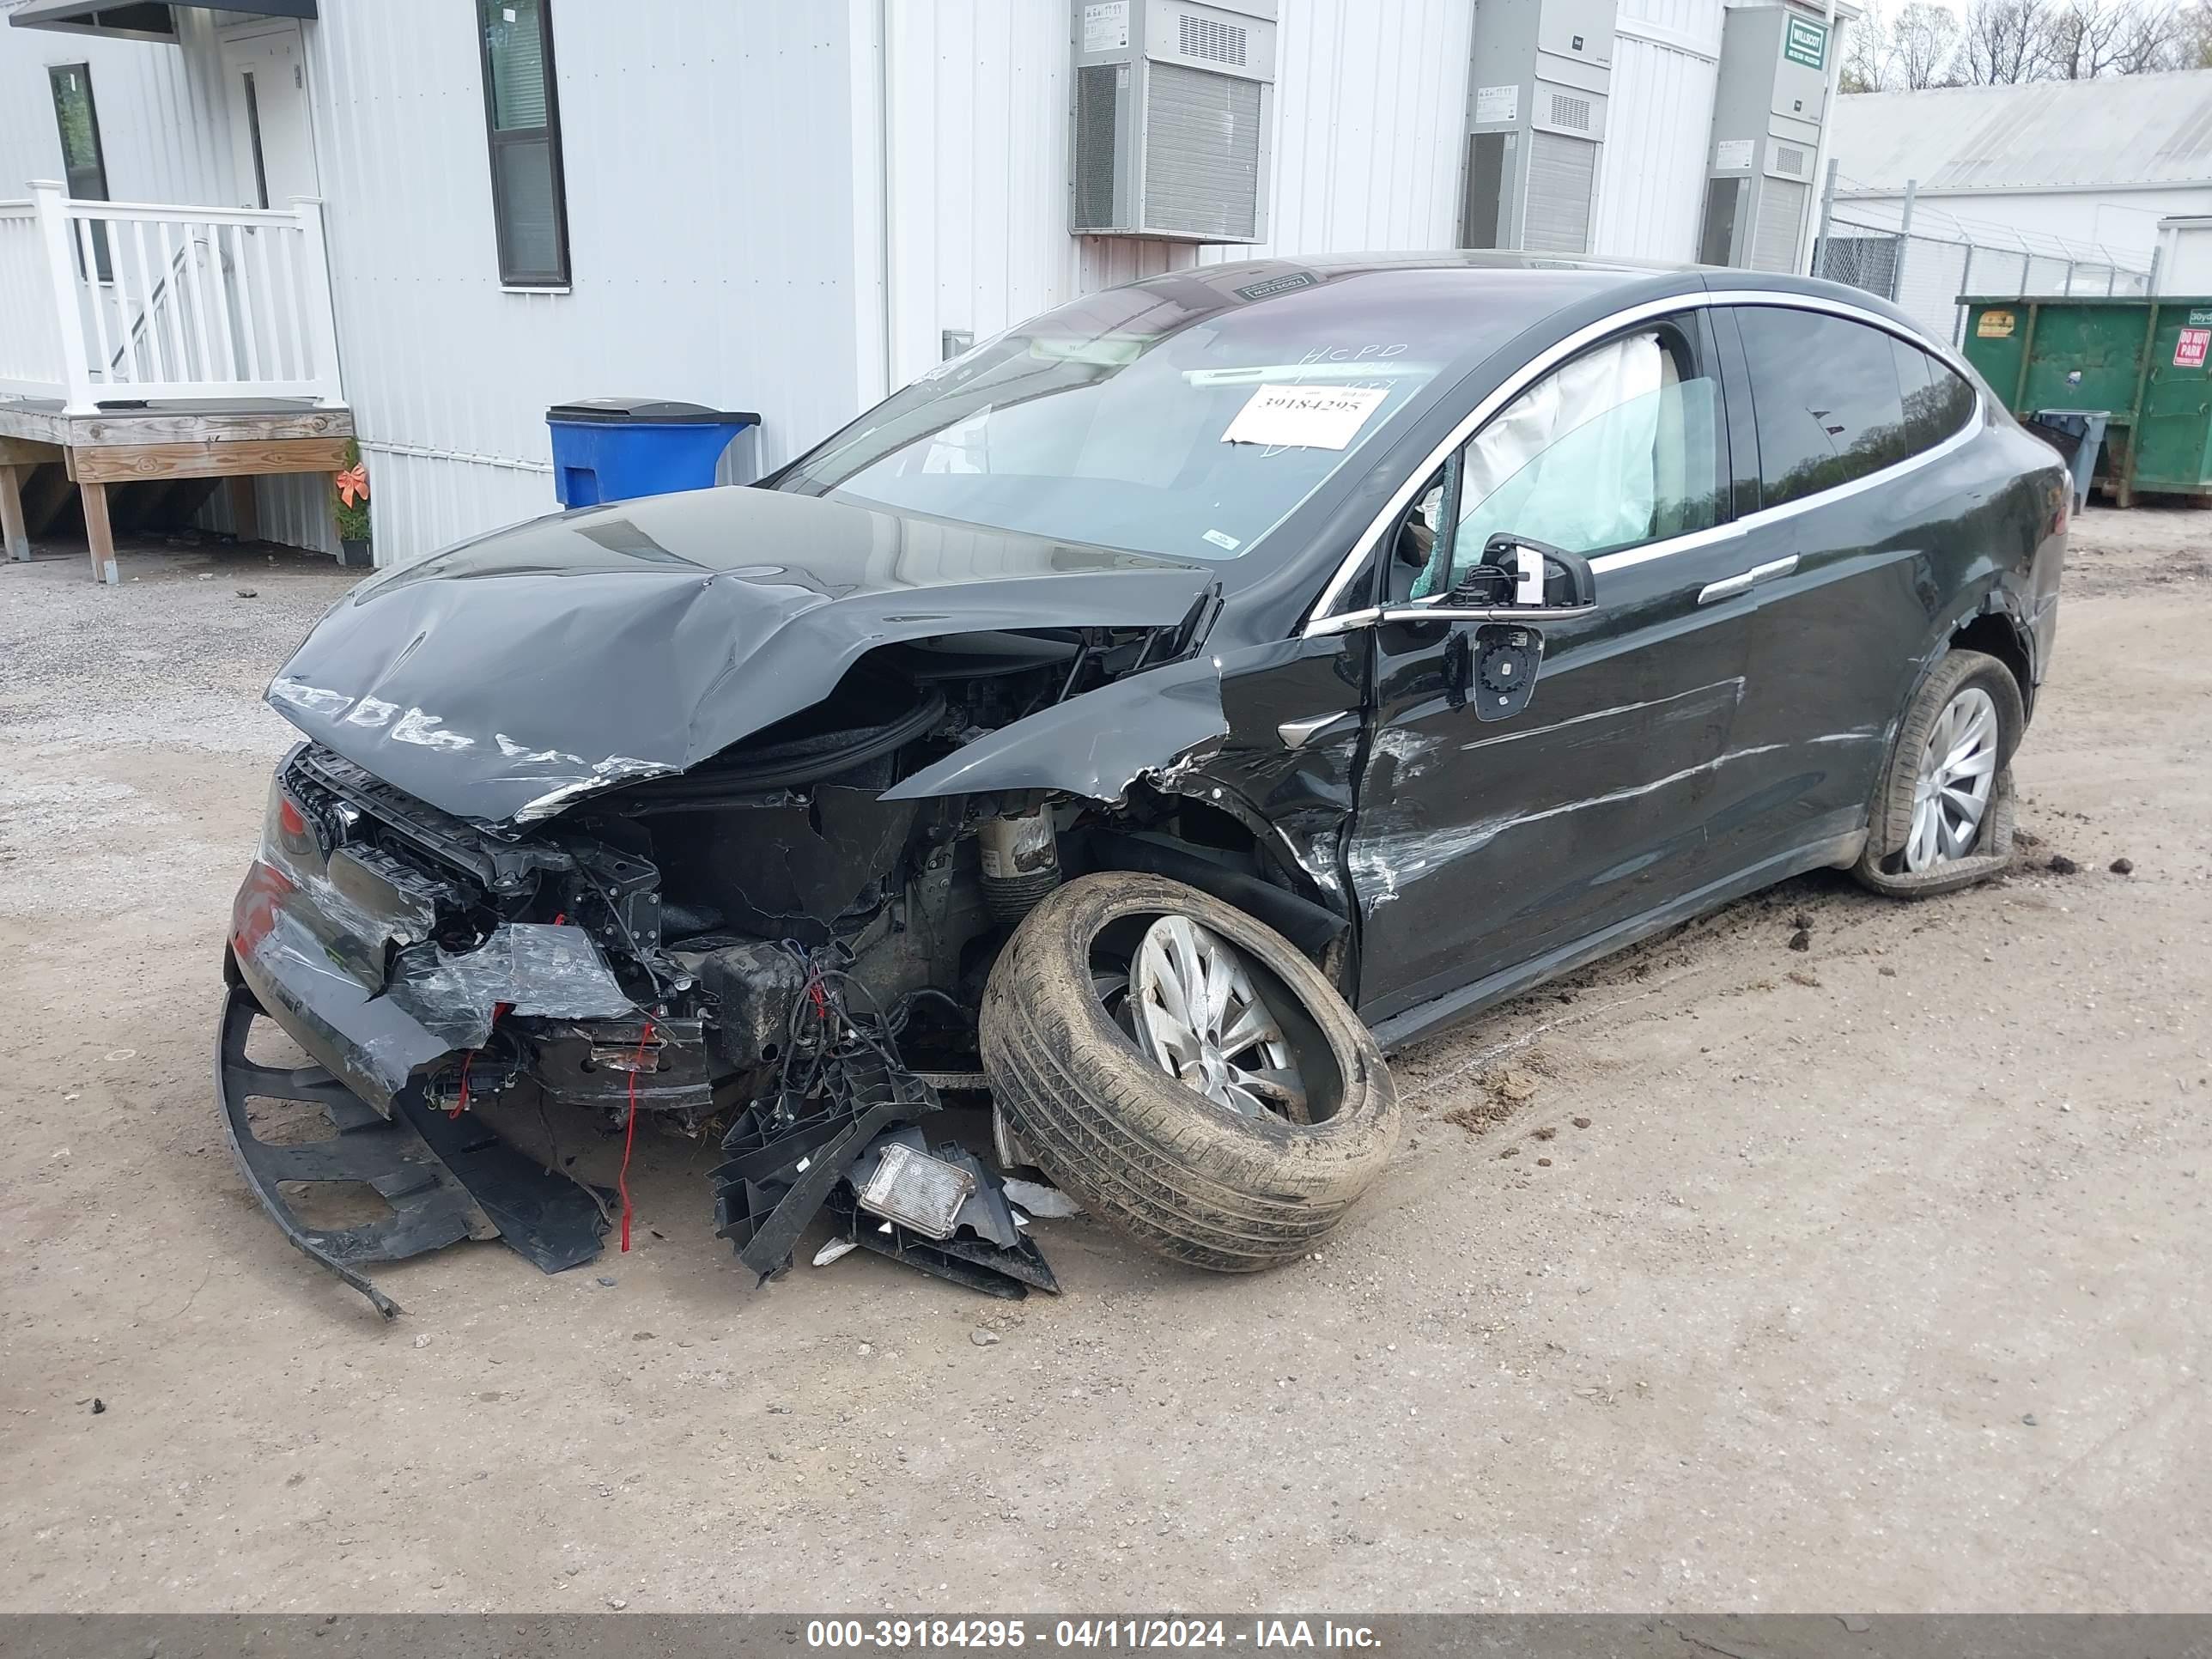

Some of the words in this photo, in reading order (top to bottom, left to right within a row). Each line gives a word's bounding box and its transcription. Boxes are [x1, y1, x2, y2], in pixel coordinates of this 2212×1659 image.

[1793, 28, 1820, 48] WILLSCOT
[2180, 331, 2192, 343] DO
[2192, 331, 2209, 344] NOT
[1297, 343, 1408, 365] HCPD
[2180, 343, 2202, 357] PARK
[1257, 397, 1363, 413] 39184295
